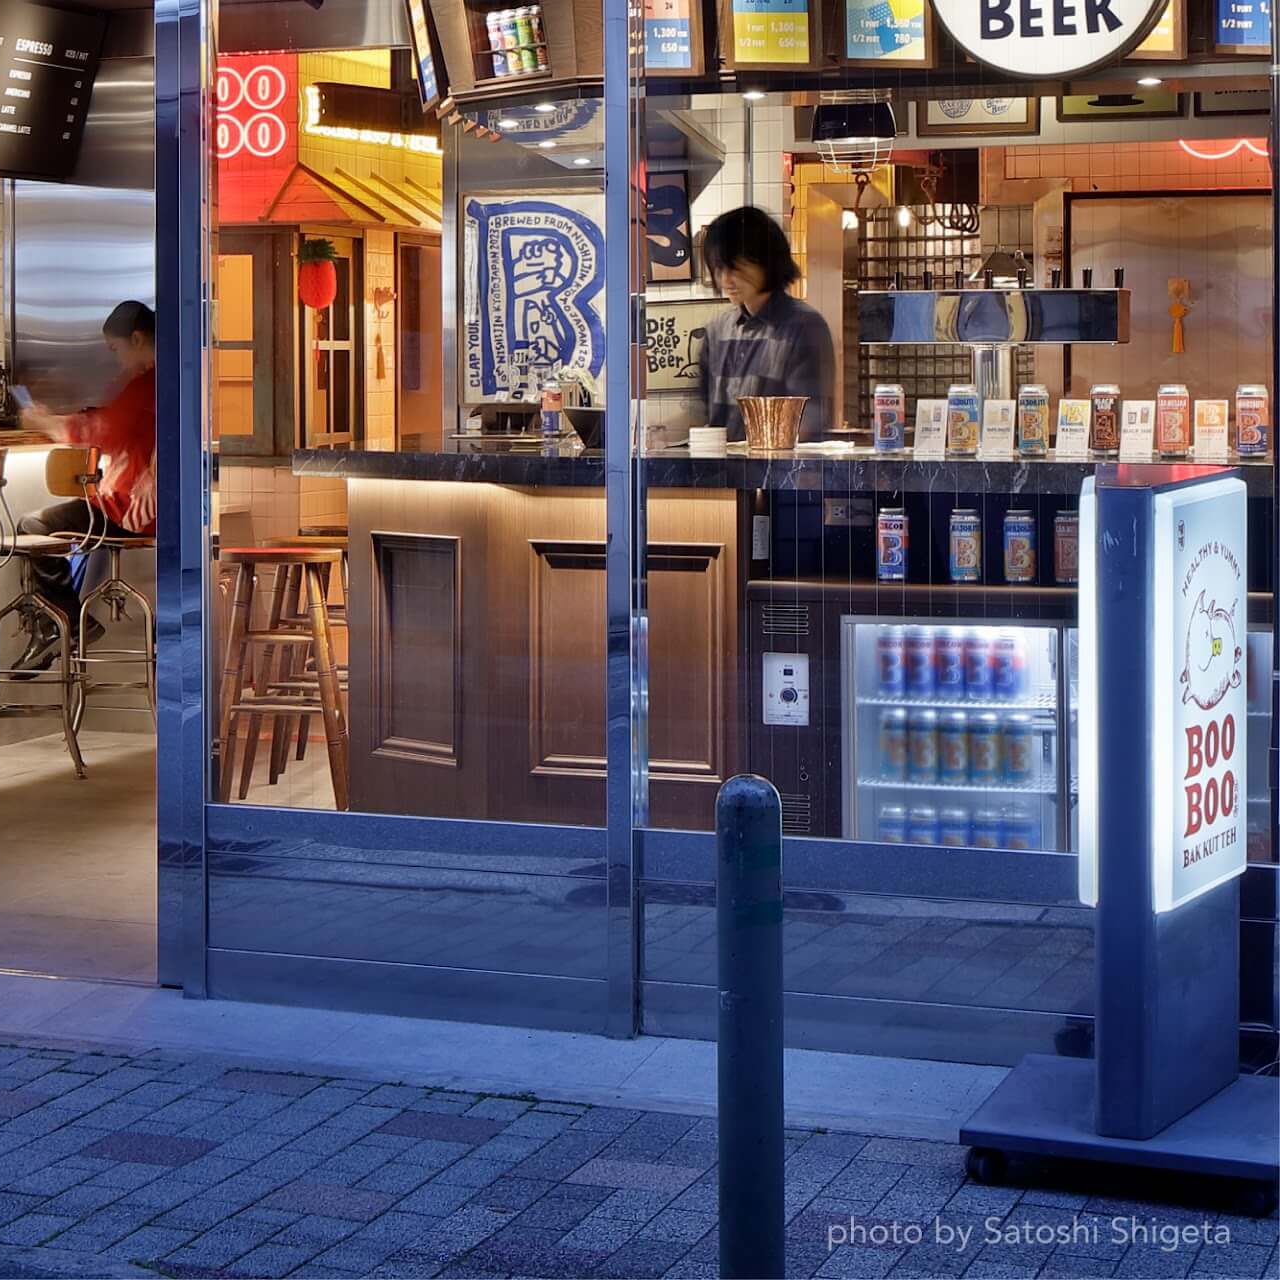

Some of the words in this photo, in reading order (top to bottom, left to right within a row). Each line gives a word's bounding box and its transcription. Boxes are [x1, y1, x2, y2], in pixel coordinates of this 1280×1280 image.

[15, 38, 54, 57] ESPRESSO
[1, 104, 17, 115] LATTE
[489, 228, 499, 250] 2023
[495, 215, 541, 229] BREWED
[544, 215, 573, 235] FROM
[571, 230, 594, 282] NISHIJIN
[493, 316, 506, 364] NISHIJIN
[569, 311, 589, 348] JAPAN
[647, 317, 676, 338] Dig
[469, 352, 481, 388] CLAP
[647, 353, 685, 374] Beer
[1181, 542, 1212, 598] HEALTHY
[1220, 543, 1241, 581] YUMMY
[1184, 713, 1235, 780] BOO
[1184, 770, 1235, 839] BOO
[1182, 842, 1202, 869] BAK
[1202, 833, 1221, 859] KUT
[1220, 825, 1237, 849] TEH
